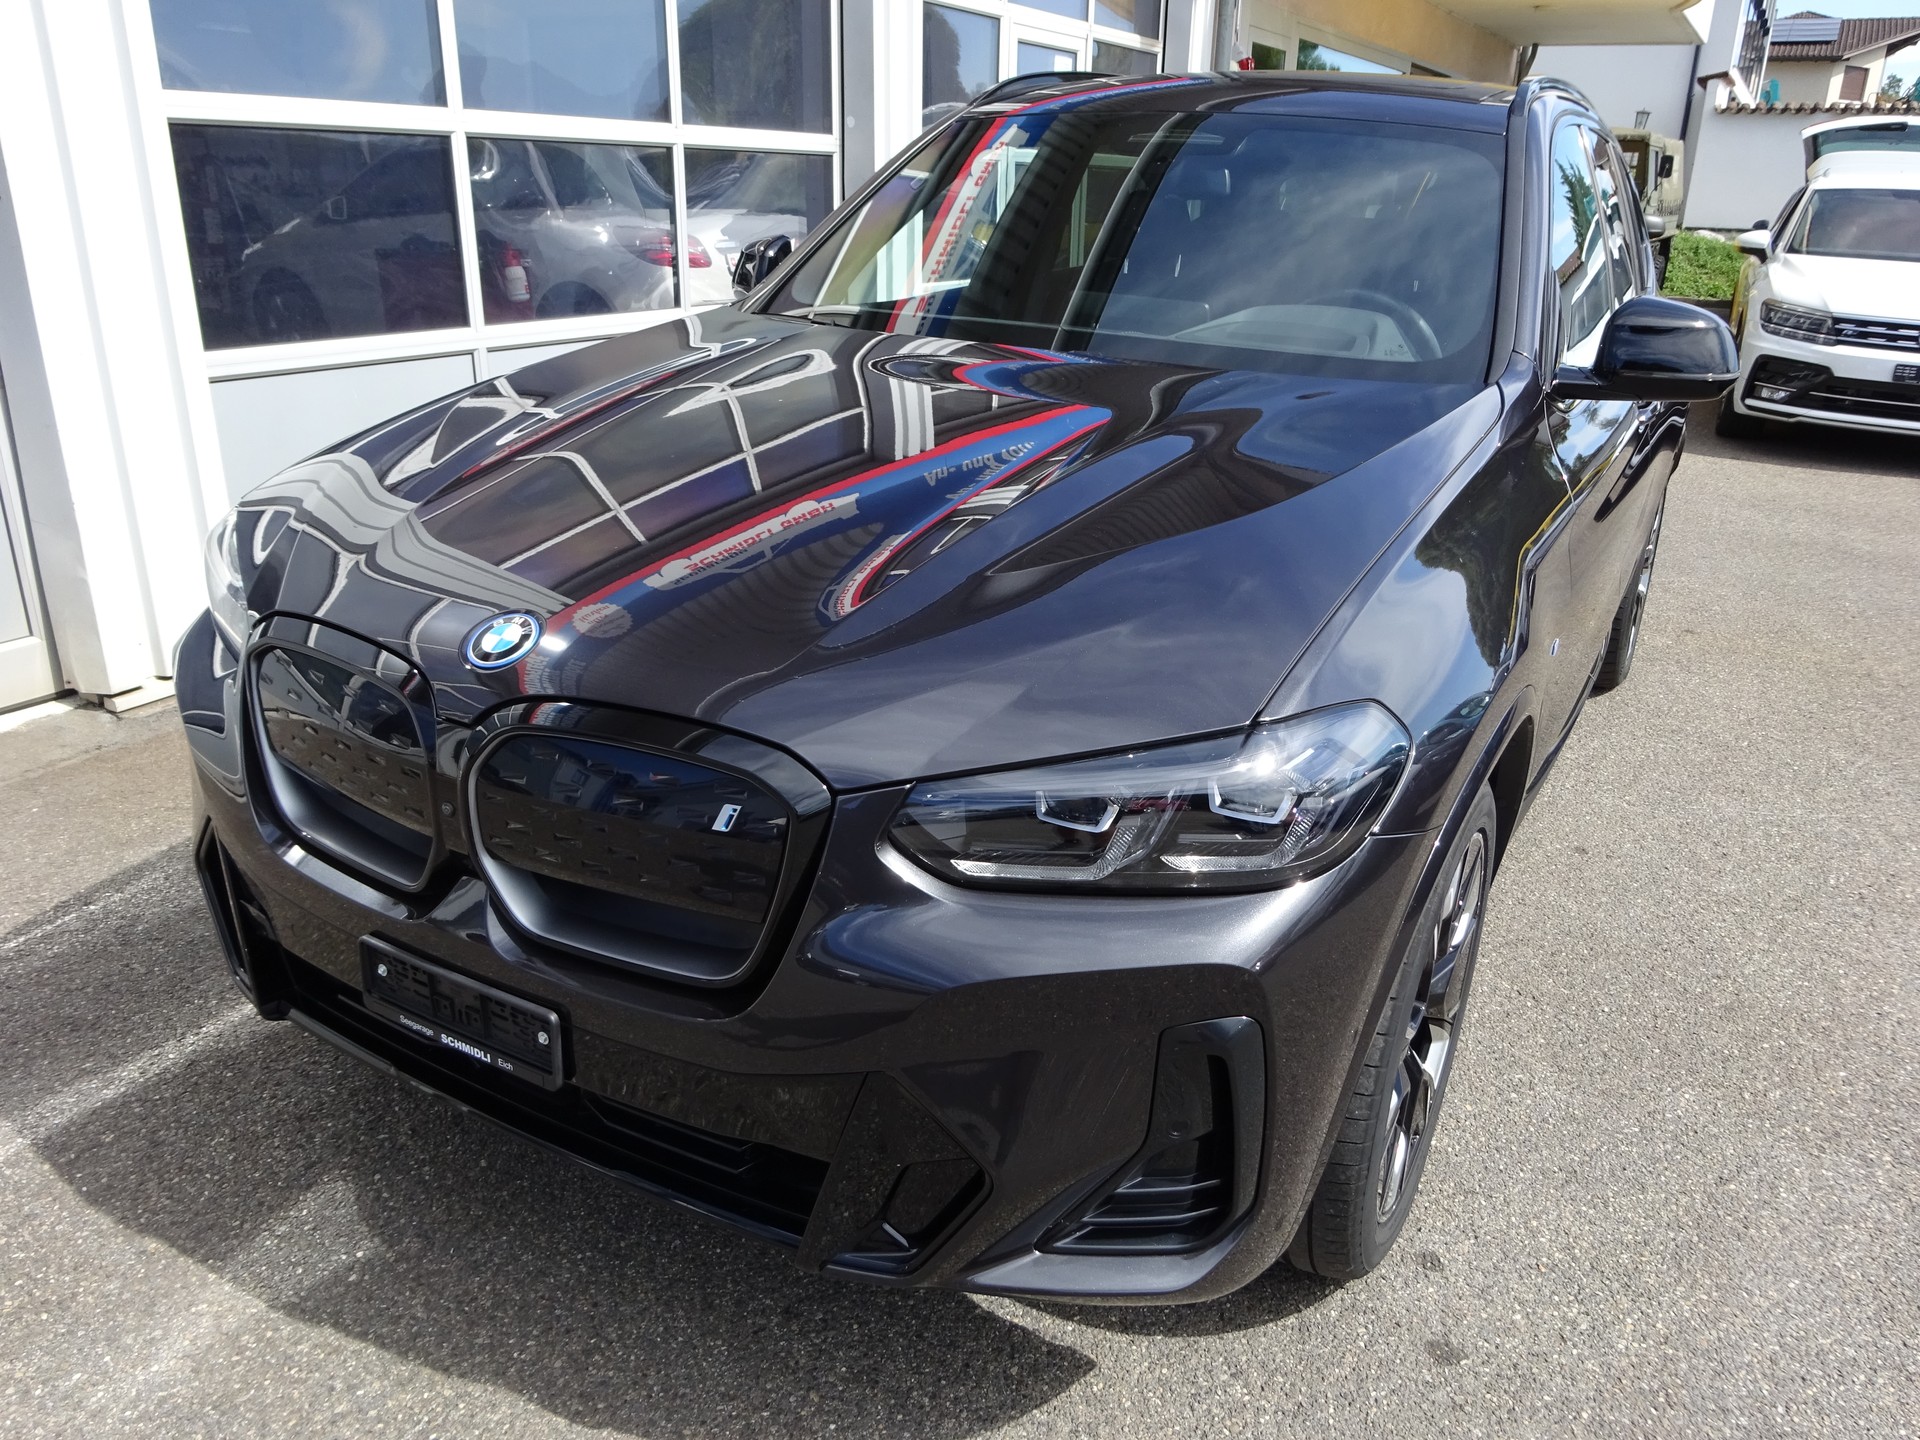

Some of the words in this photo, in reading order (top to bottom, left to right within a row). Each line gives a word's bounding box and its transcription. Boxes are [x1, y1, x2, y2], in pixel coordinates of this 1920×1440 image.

[493, 616, 533, 635] BMW
[400, 1014, 434, 1036] Seegarage
[440, 1033, 491, 1062] SCHMIDLI
[498, 1058, 513, 1071] Eich
